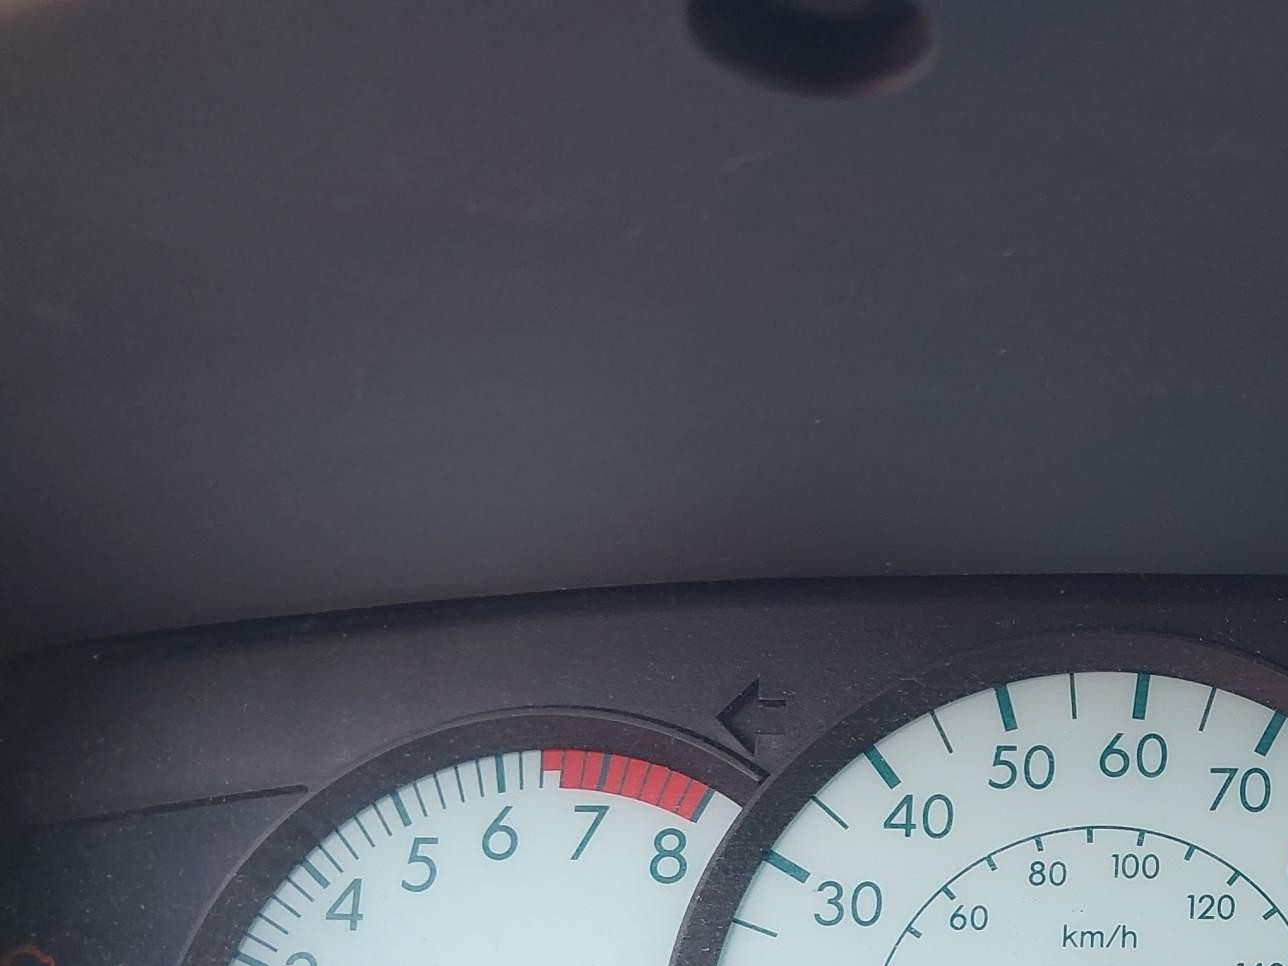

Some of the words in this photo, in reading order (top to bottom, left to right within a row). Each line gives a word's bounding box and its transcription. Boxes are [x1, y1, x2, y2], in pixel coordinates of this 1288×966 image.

[988, 744, 1055, 790] 50
[1099, 733, 1167, 778] 60
[1209, 767, 1271, 813] 70
[481, 806, 518, 860] 6
[570, 805, 609, 860] 7
[883, 794, 954, 839] 40
[402, 837, 438, 892] 5
[650, 828, 687, 884] 8
[1029, 860, 1067, 887] 80
[1111, 853, 1160, 879] 100
[326, 879, 363, 931] 4
[814, 881, 883, 926] 30
[949, 904, 989, 931] 60
[1187, 893, 1236, 921] 120
[1061, 922, 1137, 950] km/h
